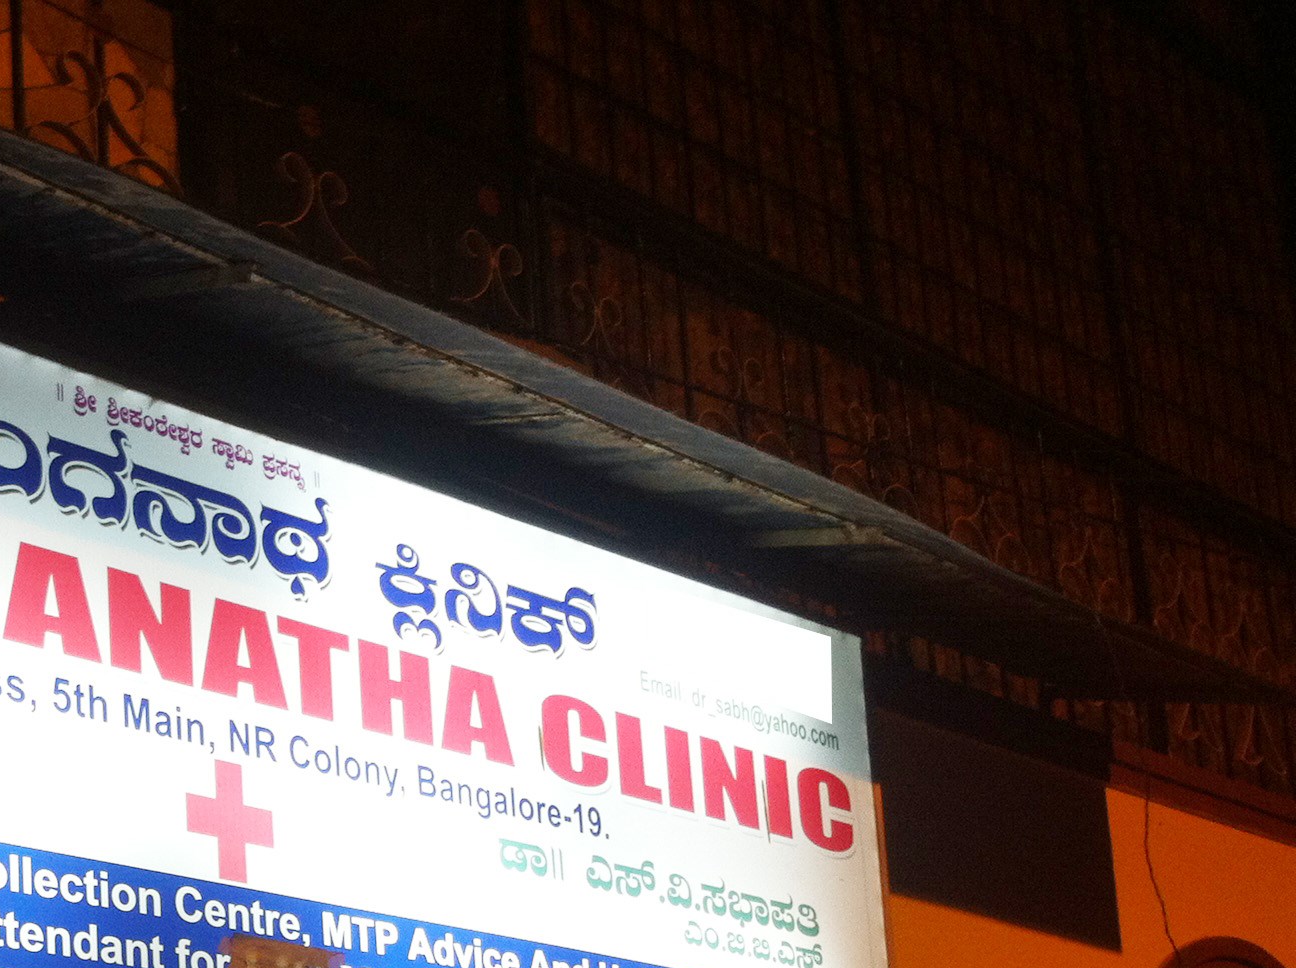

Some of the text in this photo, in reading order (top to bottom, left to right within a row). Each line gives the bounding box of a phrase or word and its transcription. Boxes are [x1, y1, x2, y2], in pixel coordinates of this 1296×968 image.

[211, 437, 254, 470] ಸ್ವಾಮಿ
[376, 543, 596, 655] ಕ್ಲಿನಿಕ್
[53, 677, 109, 722] 5th
[122, 692, 215, 753] Main,
[228, 719, 277, 762] NR
[289, 735, 405, 797] Colony,
[417, 764, 611, 839] Bangalore-19.
[541, 694, 854, 854] CLINIC
[174, 886, 311, 947] Centre,
[321, 911, 399, 956] MTP
